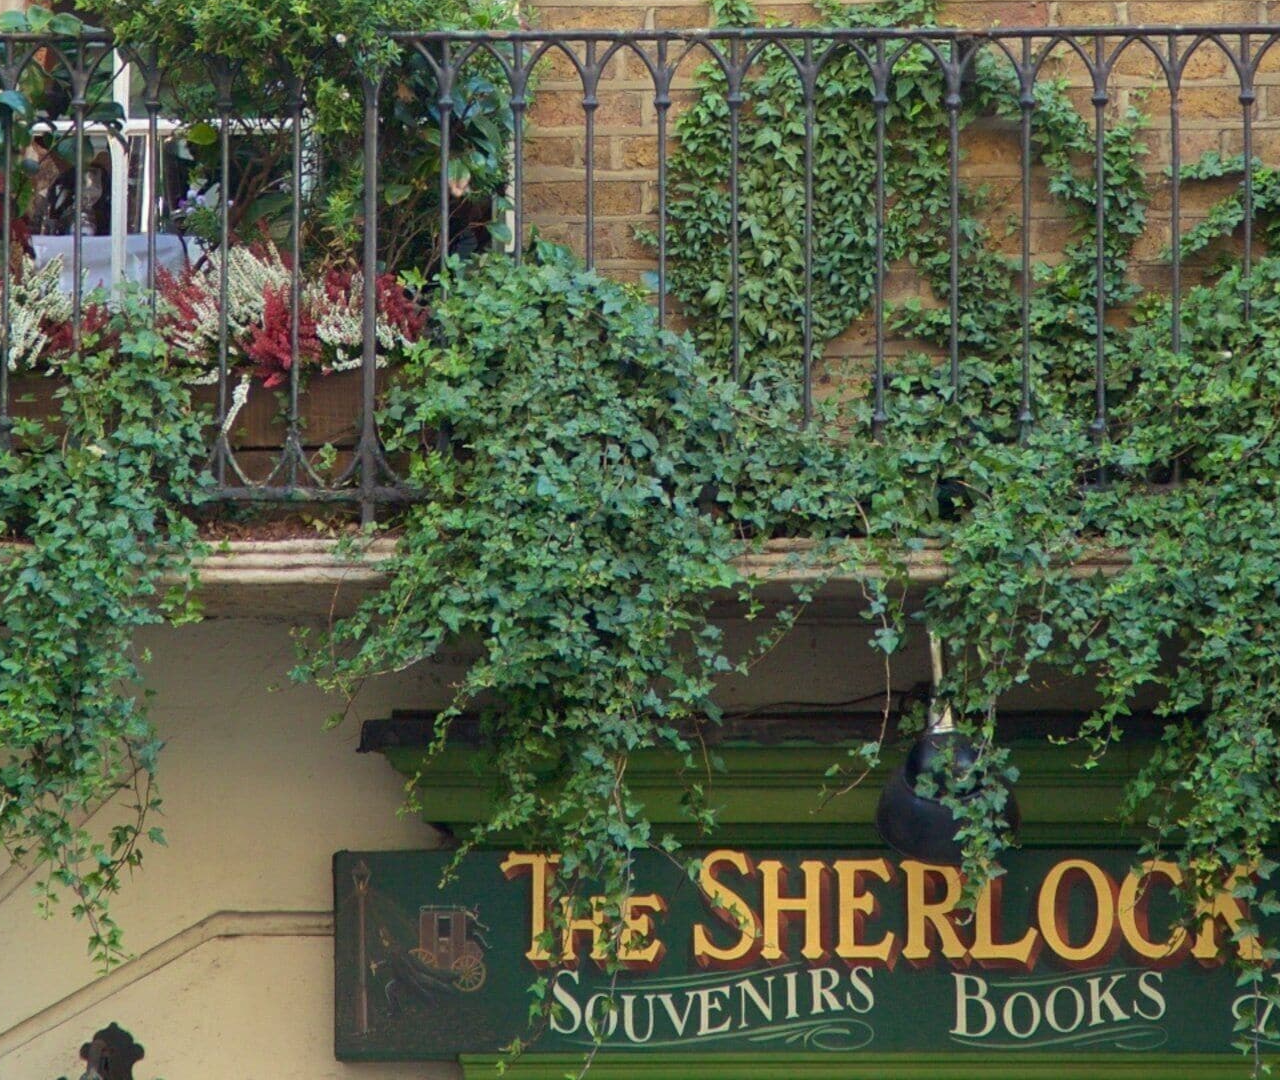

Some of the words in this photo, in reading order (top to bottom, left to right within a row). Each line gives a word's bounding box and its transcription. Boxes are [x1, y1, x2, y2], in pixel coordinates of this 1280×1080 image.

[500, 850, 665, 965] THE
[694, 849, 1265, 962] SHERLOCK
[549, 966, 875, 1044] SOUVENIRS
[949, 971, 1167, 1039] BOOKS
